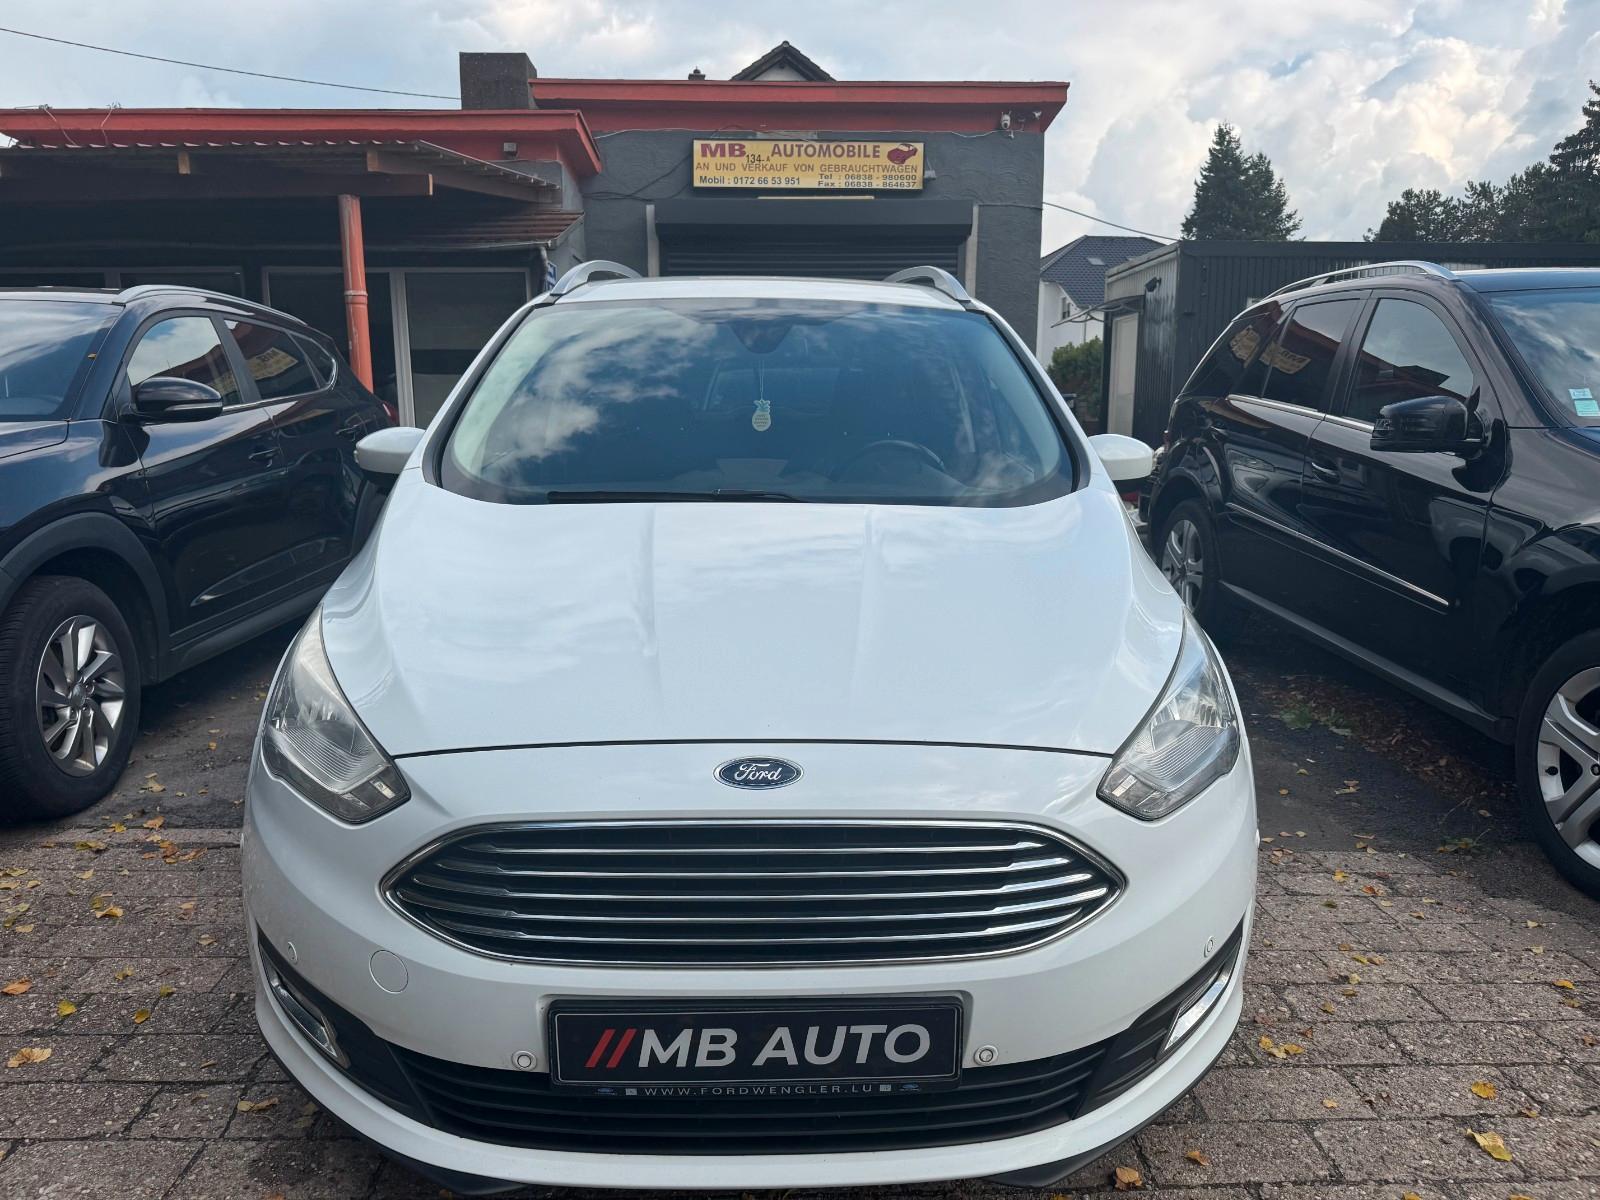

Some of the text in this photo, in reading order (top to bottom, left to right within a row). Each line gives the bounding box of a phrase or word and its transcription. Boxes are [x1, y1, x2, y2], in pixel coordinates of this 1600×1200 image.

[700, 143, 880, 158] MB AUTOMOBILE
[696, 162, 918, 173] AN UND VERKAUF VON GEBRAUCHTWAGEN
[699, 176, 725, 185] Mobil
[733, 176, 755, 185] 0172
[757, 177, 769, 185] 66
[771, 177, 782, 185] 53
[784, 177, 800, 185] 951
[734, 763, 783, 781] Ford
[752, 1024, 931, 1066] AUTO
[644, 1084, 873, 1096] WWW.FORDWENGLER.LU
